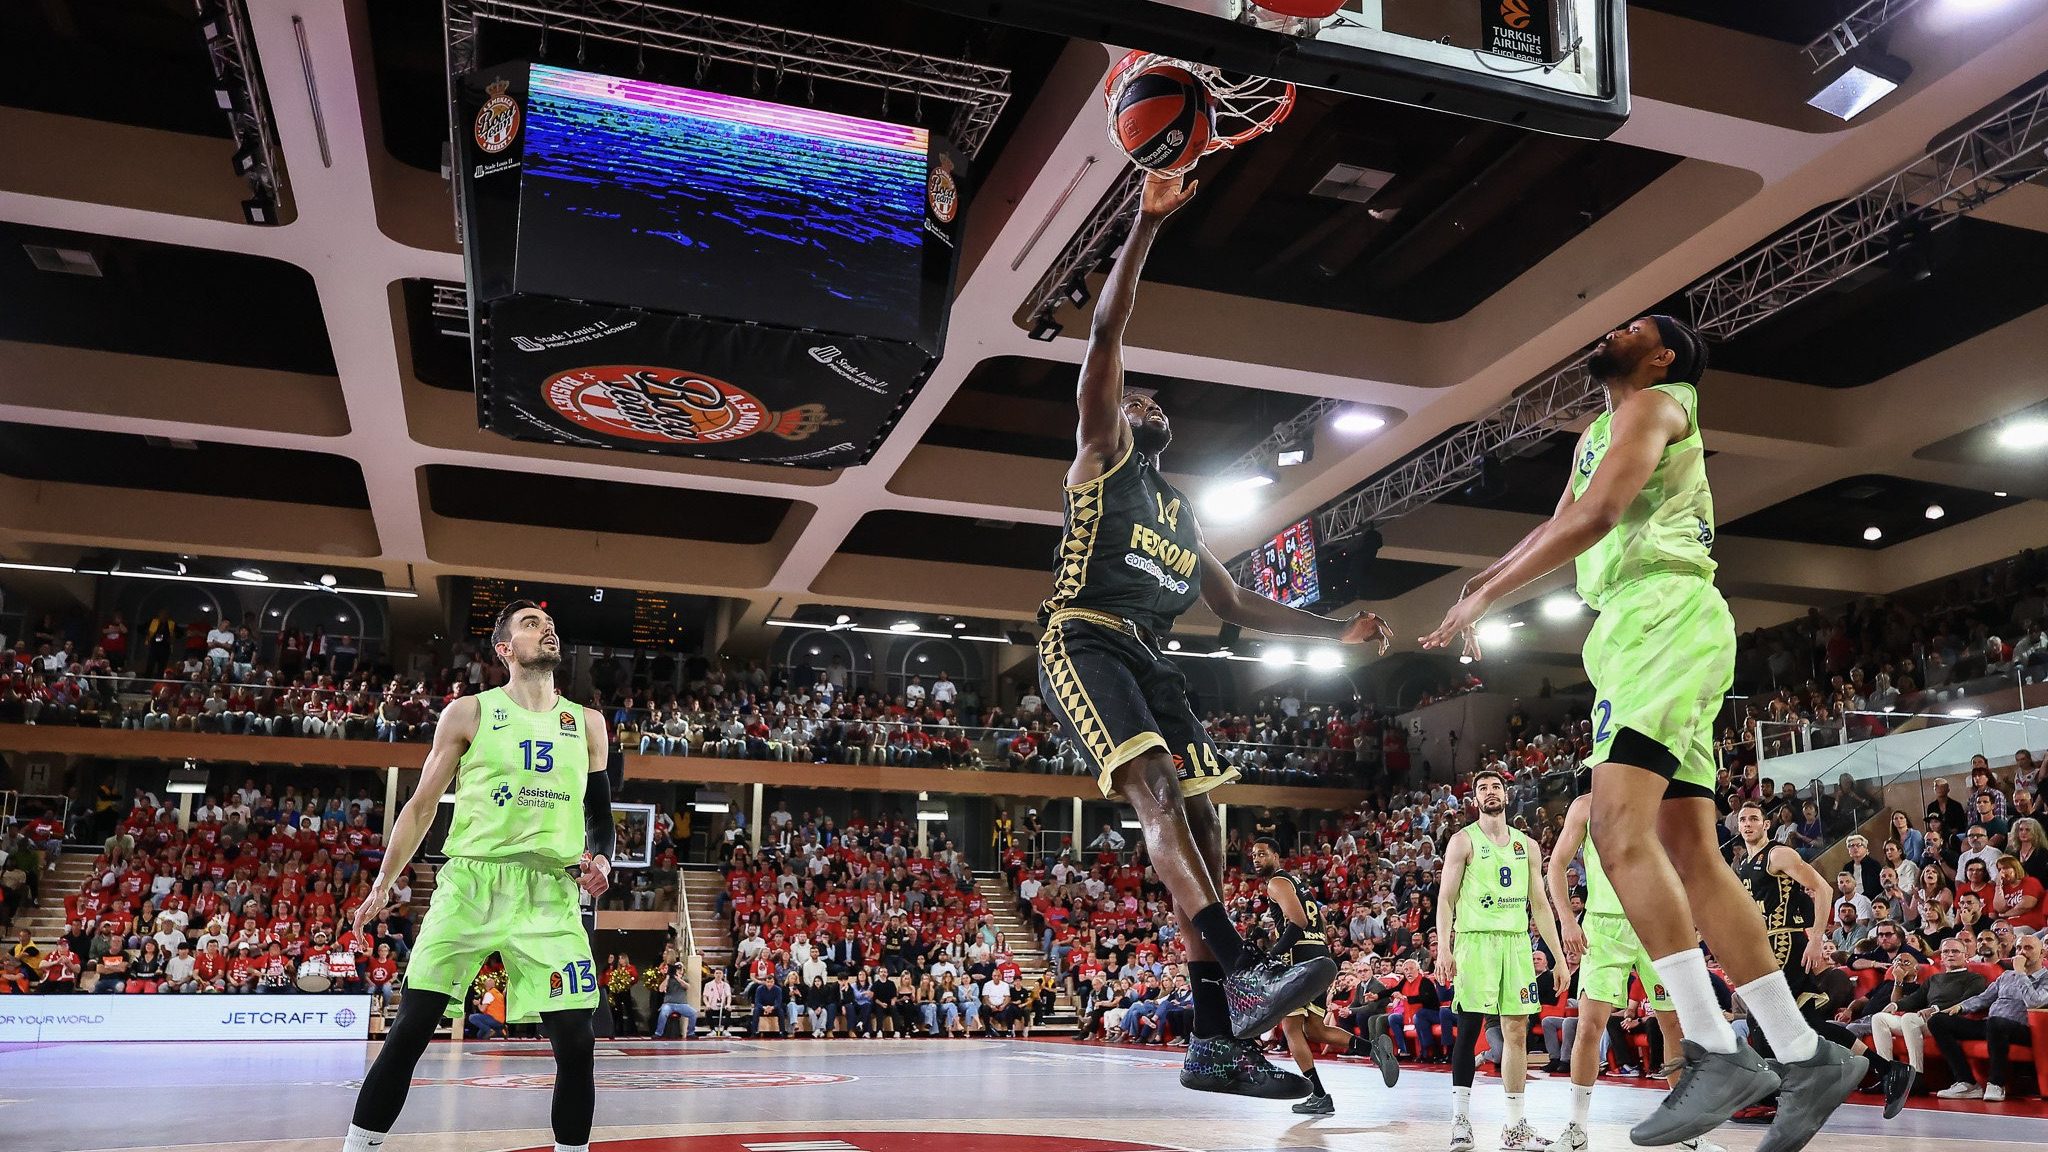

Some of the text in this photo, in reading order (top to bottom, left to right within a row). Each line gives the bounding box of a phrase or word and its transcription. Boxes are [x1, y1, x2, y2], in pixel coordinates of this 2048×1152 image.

[1492, 26, 1541, 44] TURKISH
[1492, 37, 1542, 55] AIRLINES
[534, 321, 609, 343] Stade Louis II
[603, 321, 637, 335] MONACO
[550, 376, 585, 412] BASKET
[703, 411, 761, 440] MONACO
[1156, 491, 1181, 533] 14
[518, 739, 554, 773] 13
[1186, 742, 1222, 778] 14
[518, 785, 571, 802] Assistència
[1499, 866, 1512, 888] 8
[562, 959, 596, 995] 13
[1529, 982, 1538, 1004] 8
[18, 1015, 55, 1025] YOUR
[56, 1015, 105, 1025] WORLD
[222, 1012, 328, 1024] JETCRAFT
